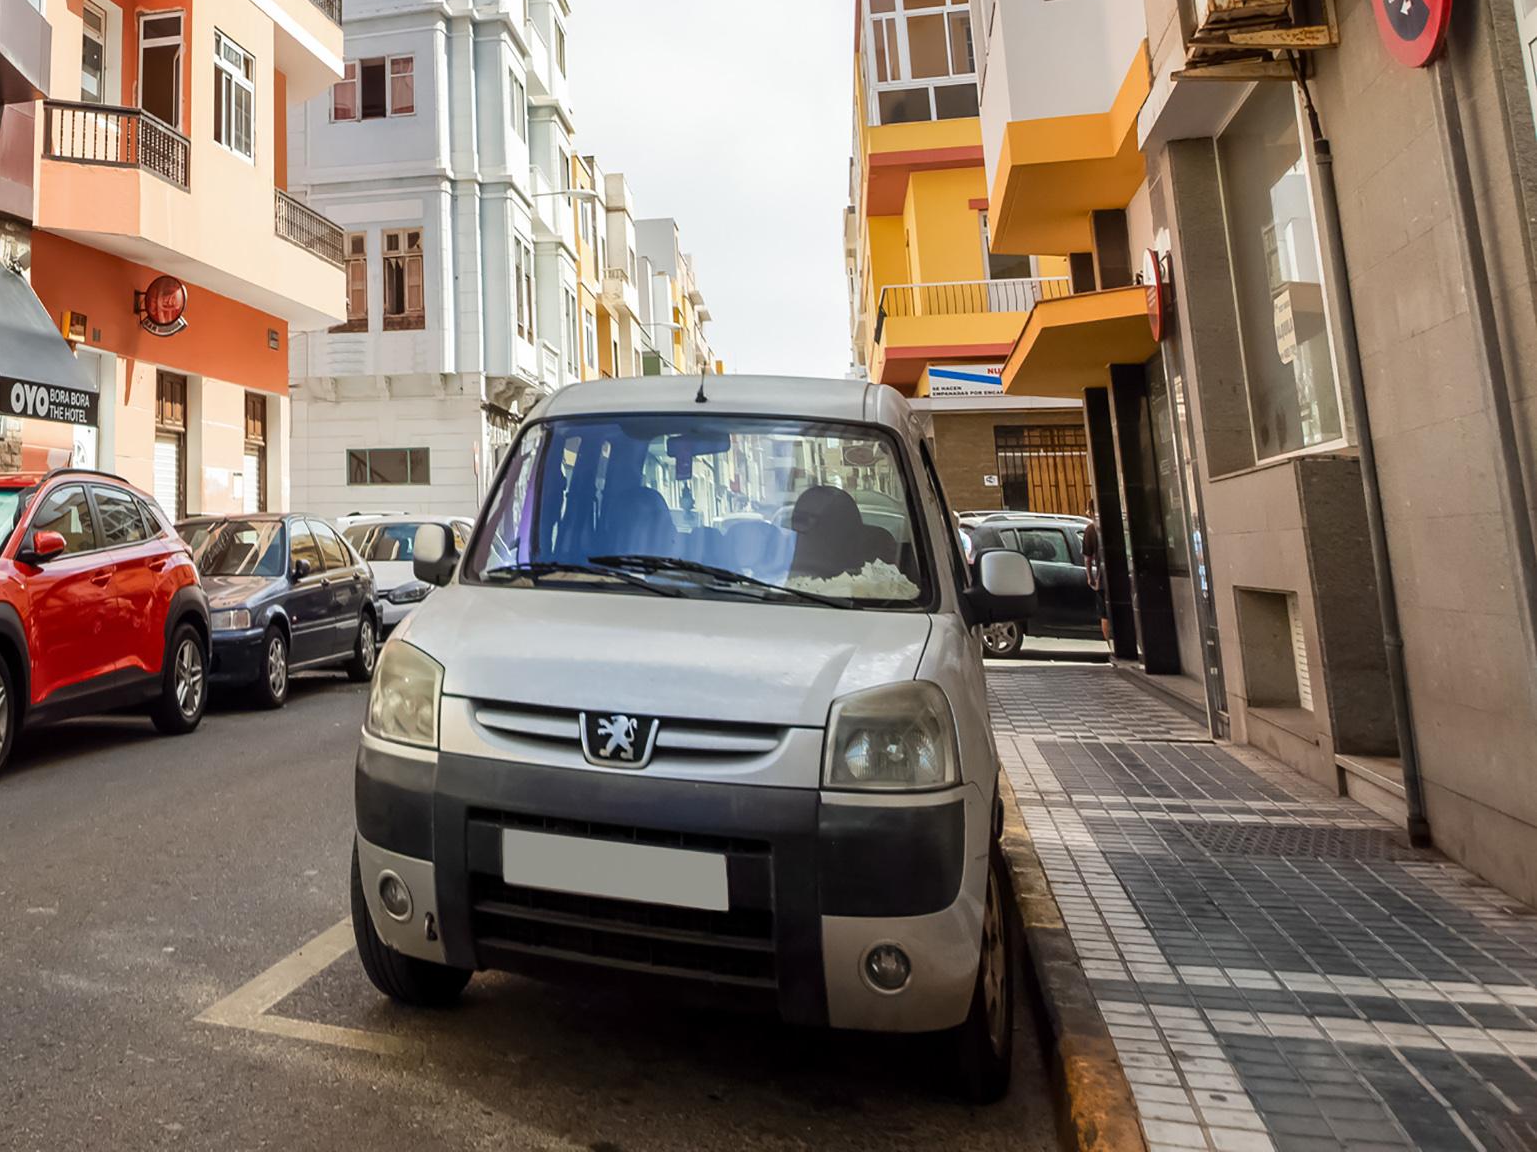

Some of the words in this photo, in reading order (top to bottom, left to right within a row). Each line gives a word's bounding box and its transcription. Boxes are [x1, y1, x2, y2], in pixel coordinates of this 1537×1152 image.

[10, 382, 49, 417] OYO
[50, 388, 70, 403] BORA
[71, 392, 90, 408] BORA
[50, 405, 63, 419] THE
[64, 408, 88, 423] HOTEL
